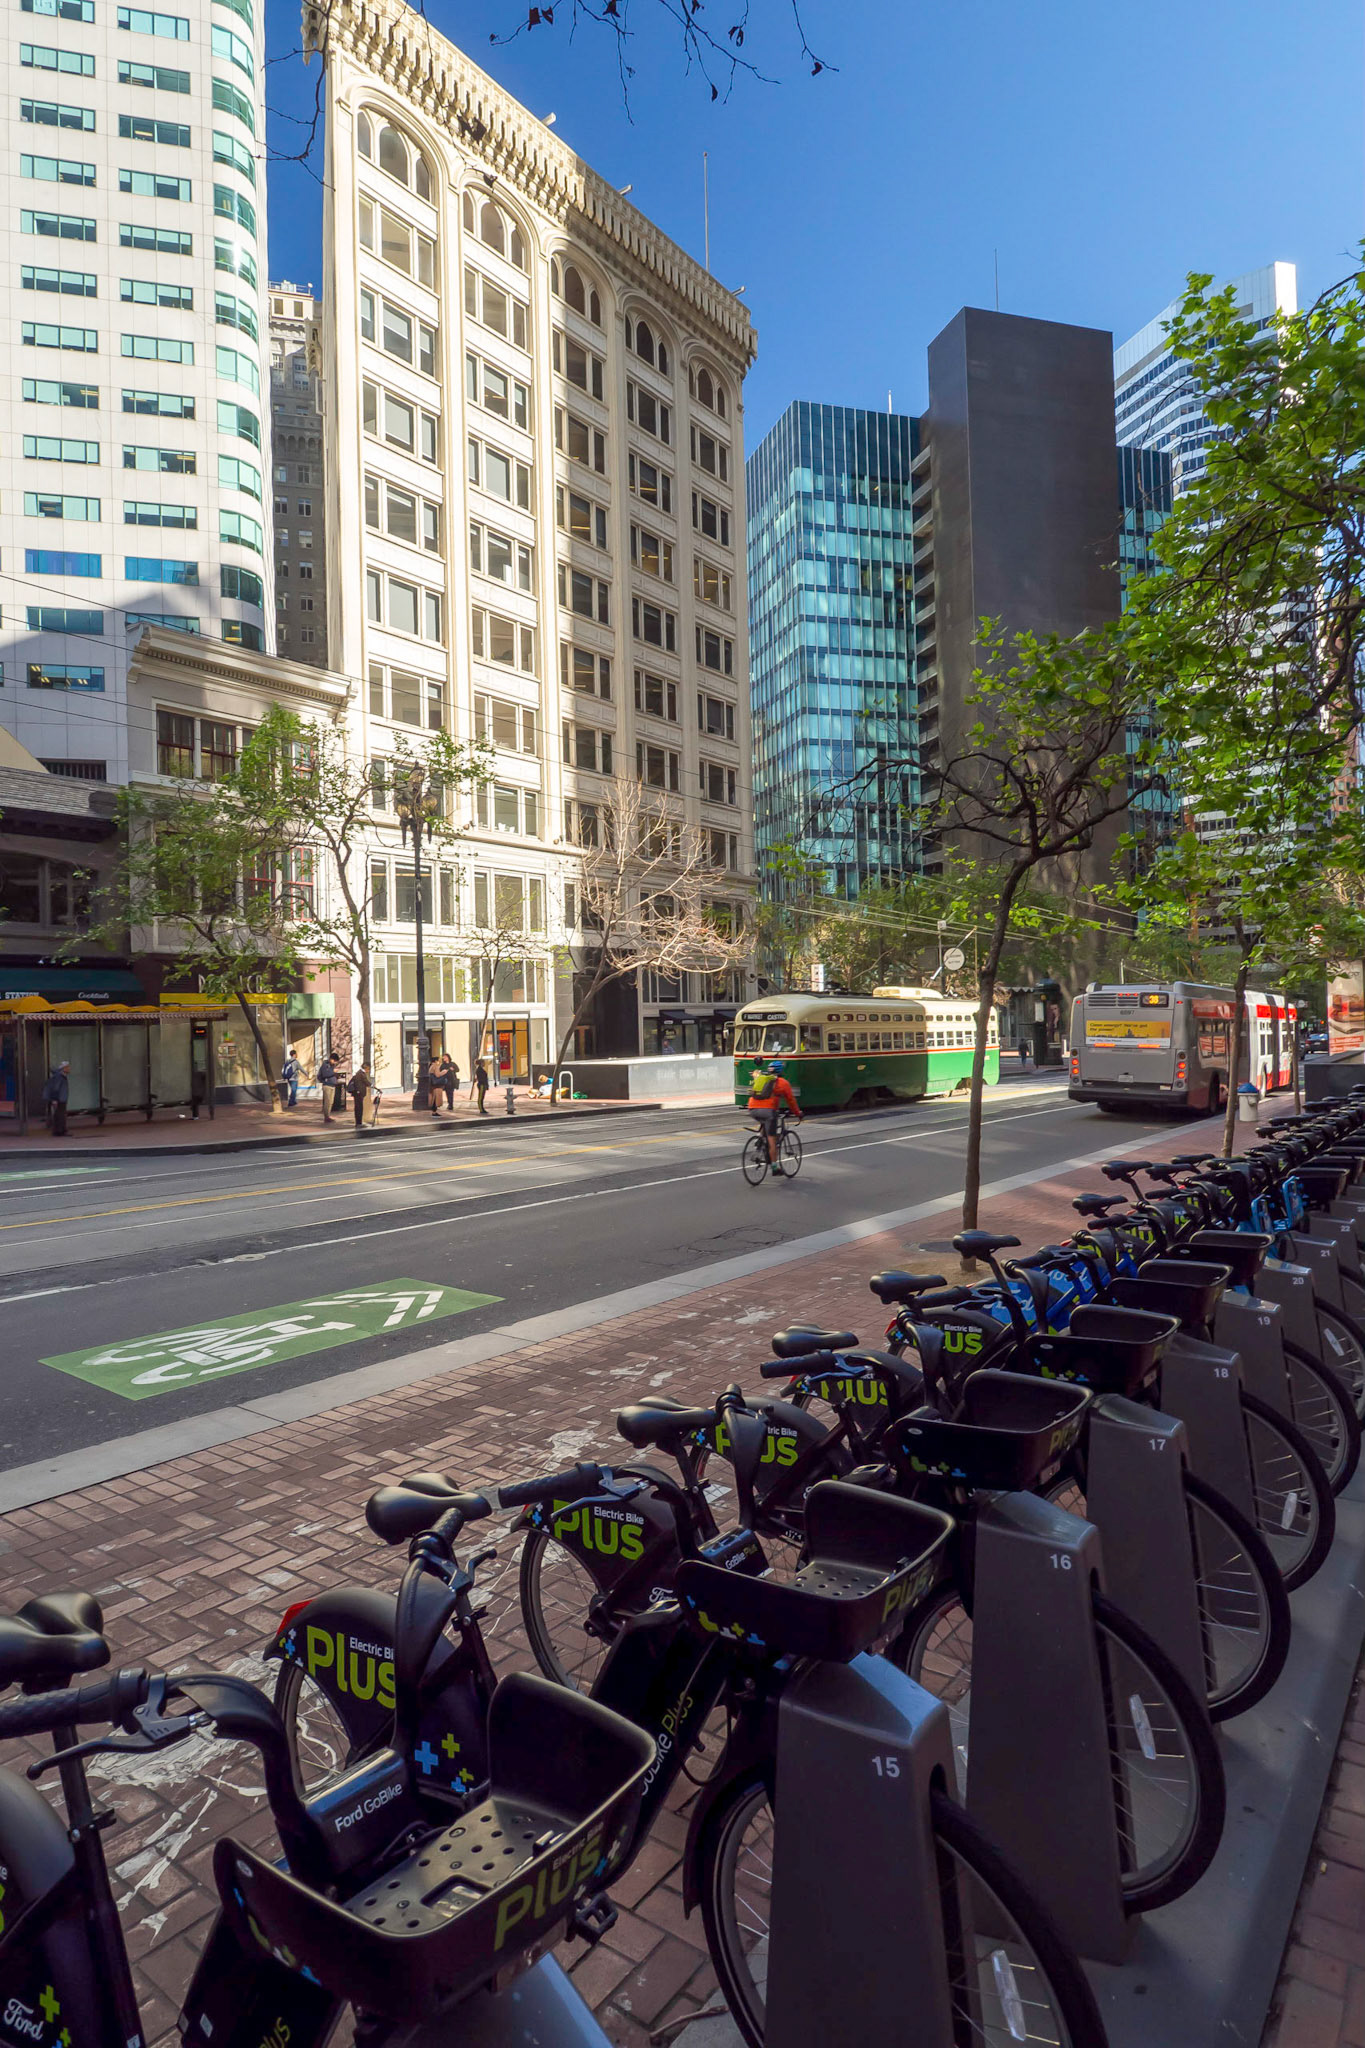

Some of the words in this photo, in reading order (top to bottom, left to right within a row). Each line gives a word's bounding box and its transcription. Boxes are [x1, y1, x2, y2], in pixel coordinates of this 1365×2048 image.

[1292, 1277, 1304, 1285] 20
[944, 1324, 967, 1332] Electric
[968, 1325, 983, 1333] Bike
[1258, 1316, 1271, 1326] 19
[1214, 1368, 1229, 1378] 18
[781, 1427, 798, 1437] Bike
[1149, 1438, 1166, 1451] 17
[594, 1506, 624, 1521] Electric
[625, 1512, 645, 1525] Bike
[1050, 1554, 1072, 1570] 16
[348, 1636, 382, 1657] Electric
[383, 1646, 395, 1660] Bi
[306, 1625, 397, 1710] Plus
[871, 1756, 900, 1778] 15
[334, 1804, 364, 1833] Ford
[363, 1783, 403, 1813] GoBike
[3, 1998, 45, 2041] Ford
